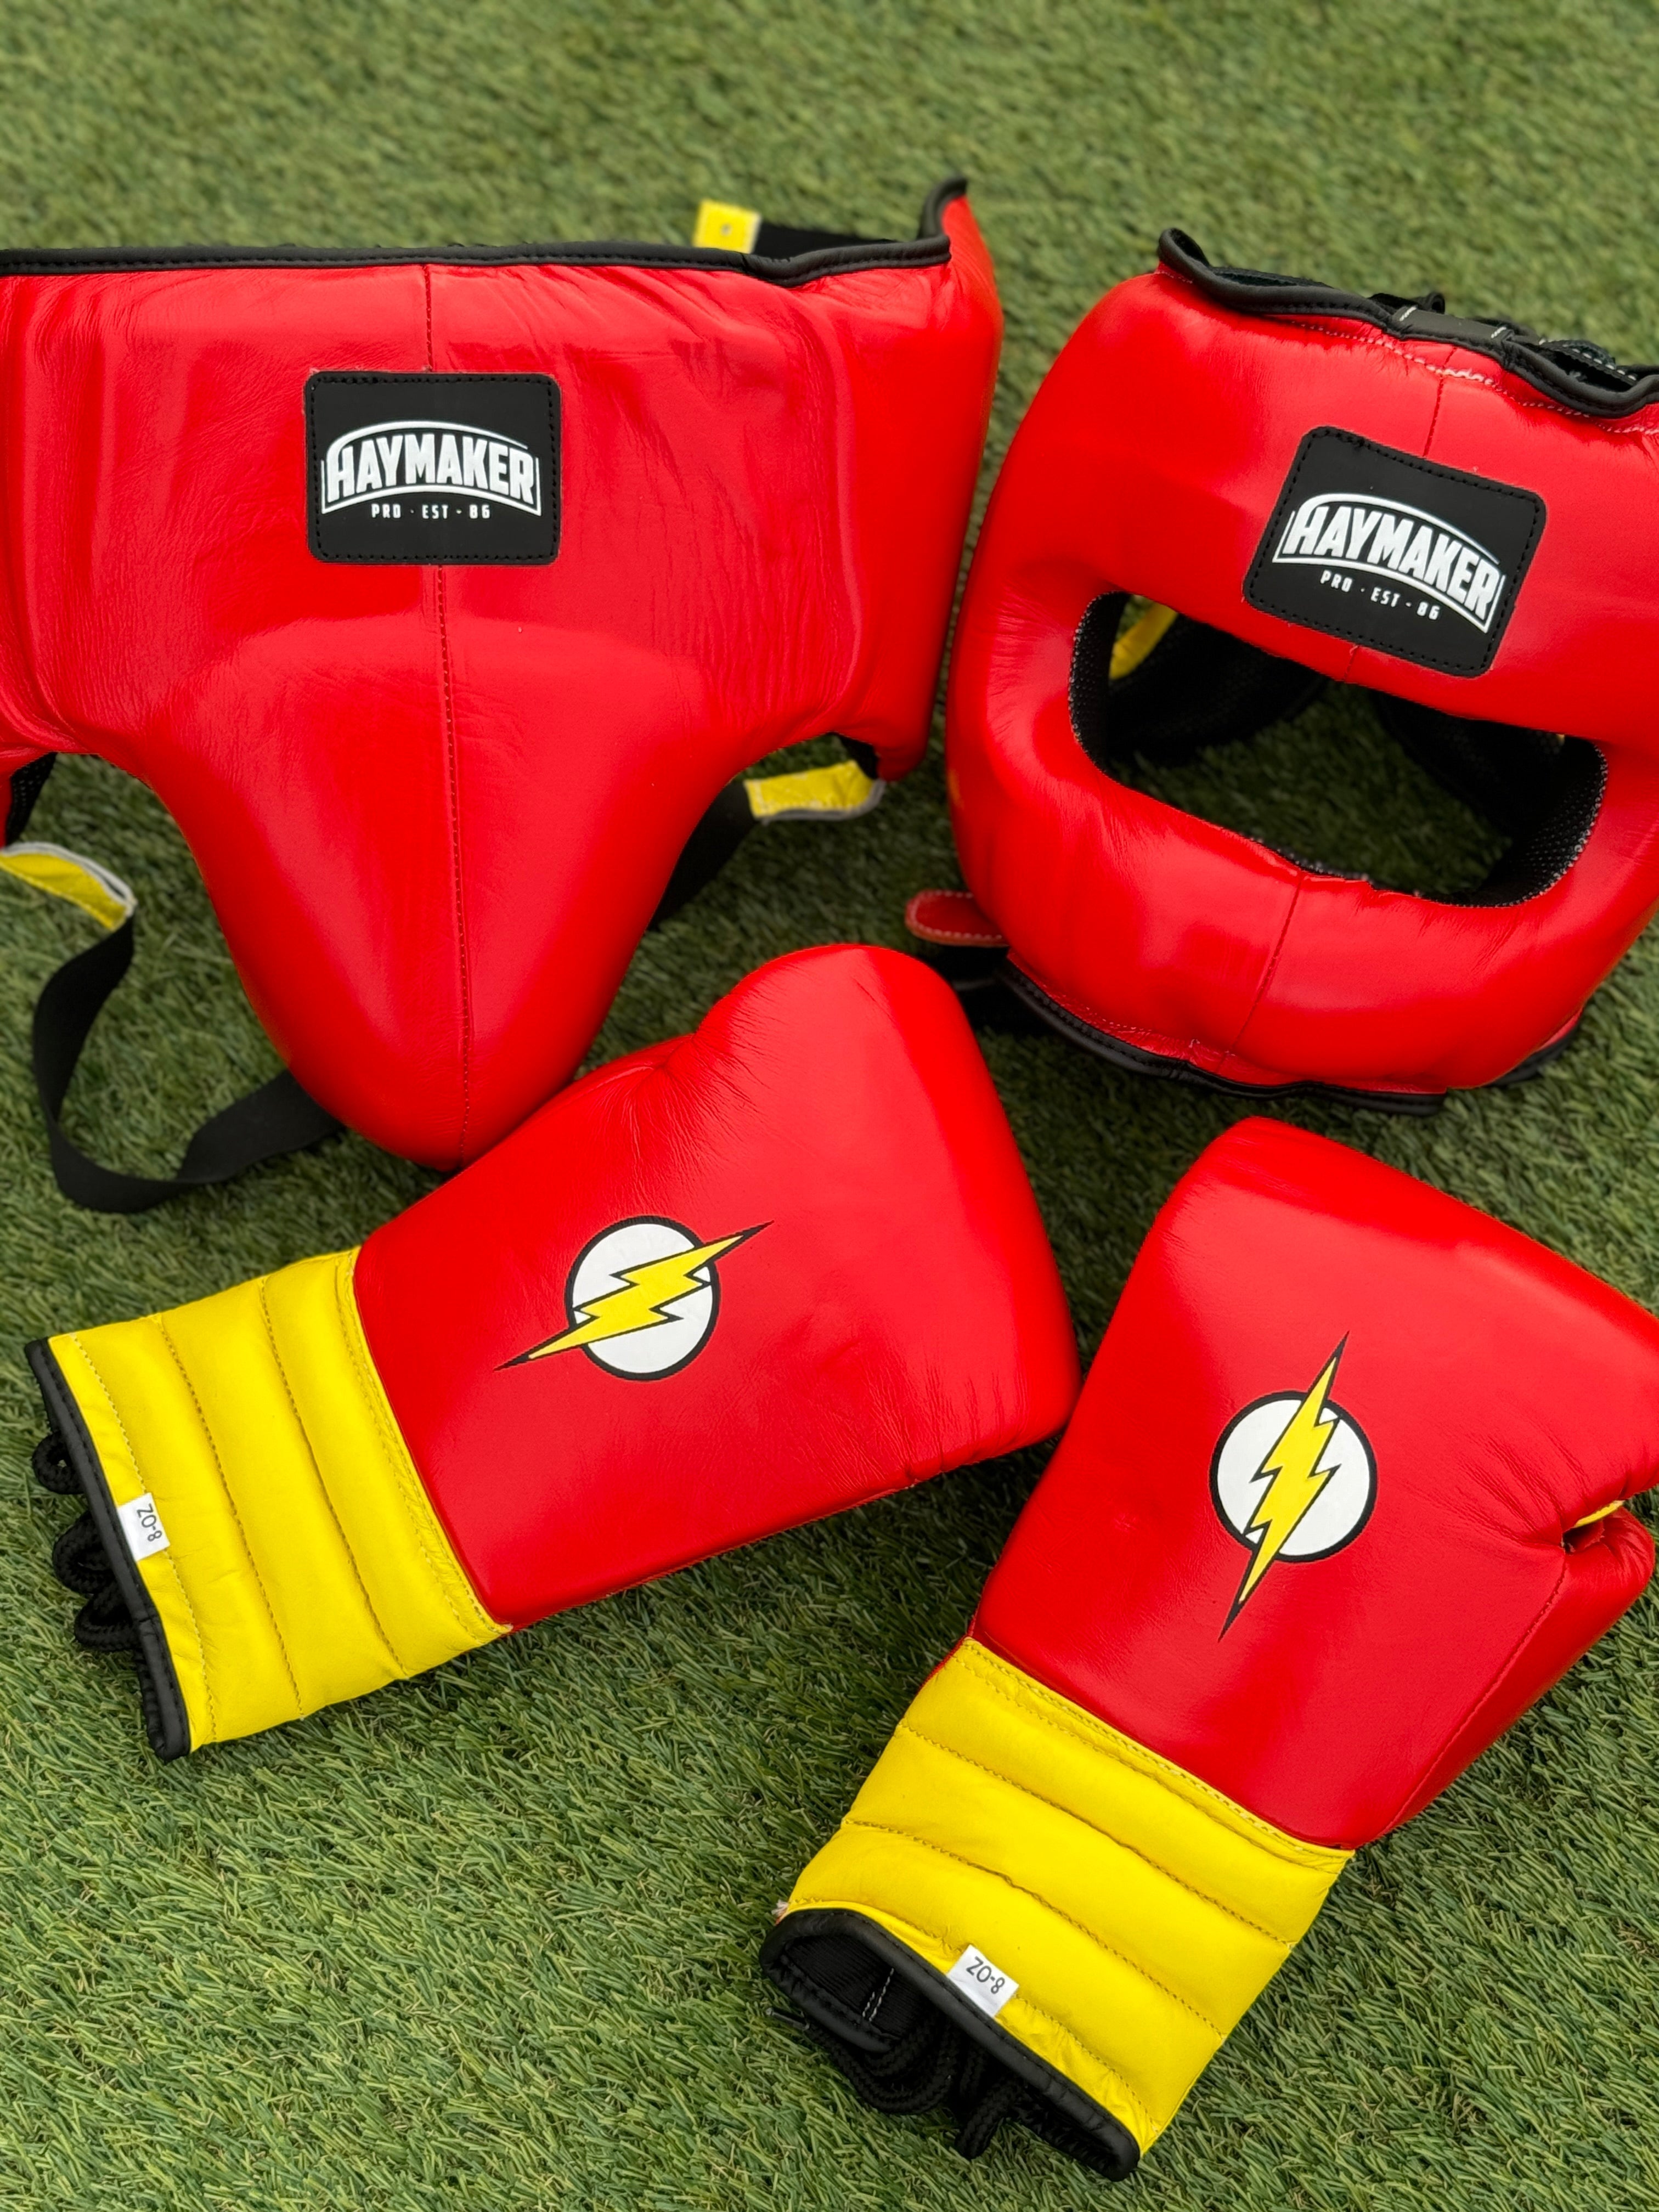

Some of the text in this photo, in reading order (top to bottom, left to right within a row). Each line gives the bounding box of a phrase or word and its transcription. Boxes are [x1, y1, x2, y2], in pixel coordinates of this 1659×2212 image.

[326, 432, 535, 505] HAYMAKER
[371, 503, 401, 518] PRO
[422, 504, 448, 519] EST
[1282, 506, 1500, 620] HAYMAKER
[1320, 569, 1353, 592] PRO
[1370, 586, 1400, 608] EST
